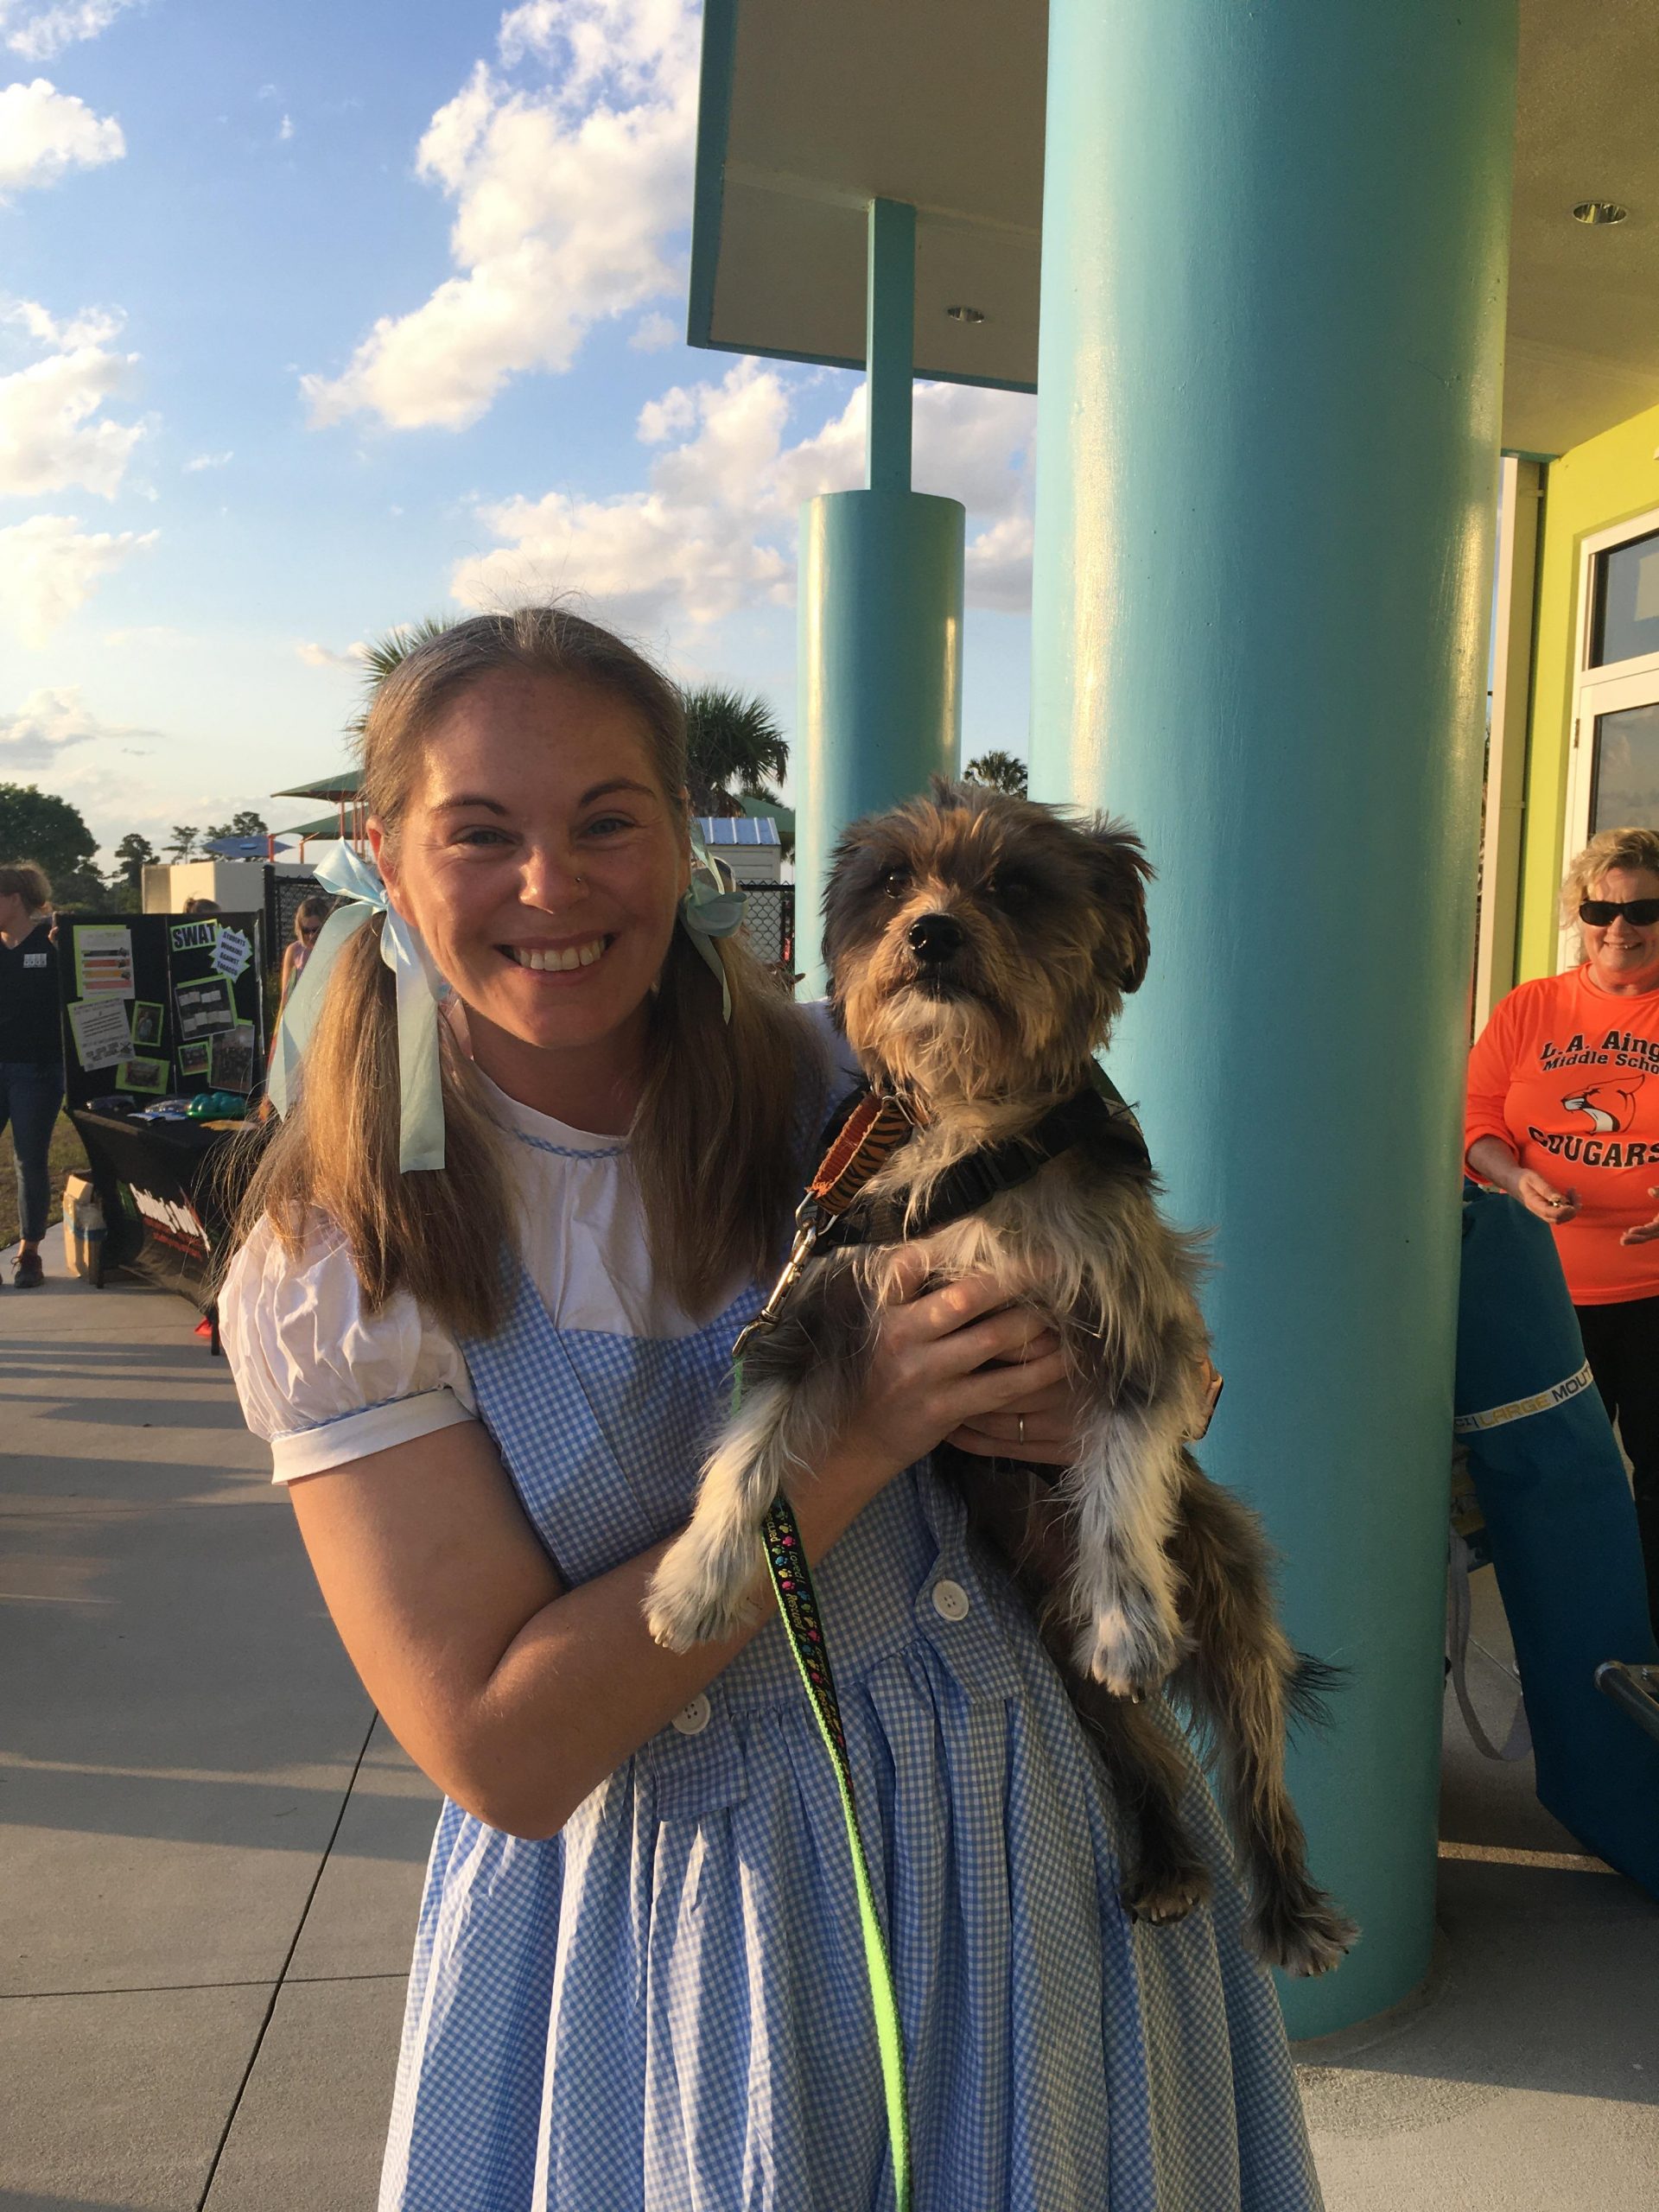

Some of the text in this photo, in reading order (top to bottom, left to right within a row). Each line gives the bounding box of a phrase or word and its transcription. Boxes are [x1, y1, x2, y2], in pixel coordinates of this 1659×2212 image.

[173, 923, 215, 949] SWAT
[1542, 1050, 1608, 1071] Middle
[1528, 1126, 1659, 1167] COUGARS
[1479, 1395, 1552, 1426] LARGE
[789, 1550, 805, 1584] Loved!
[786, 1593, 806, 1631] Rescued
